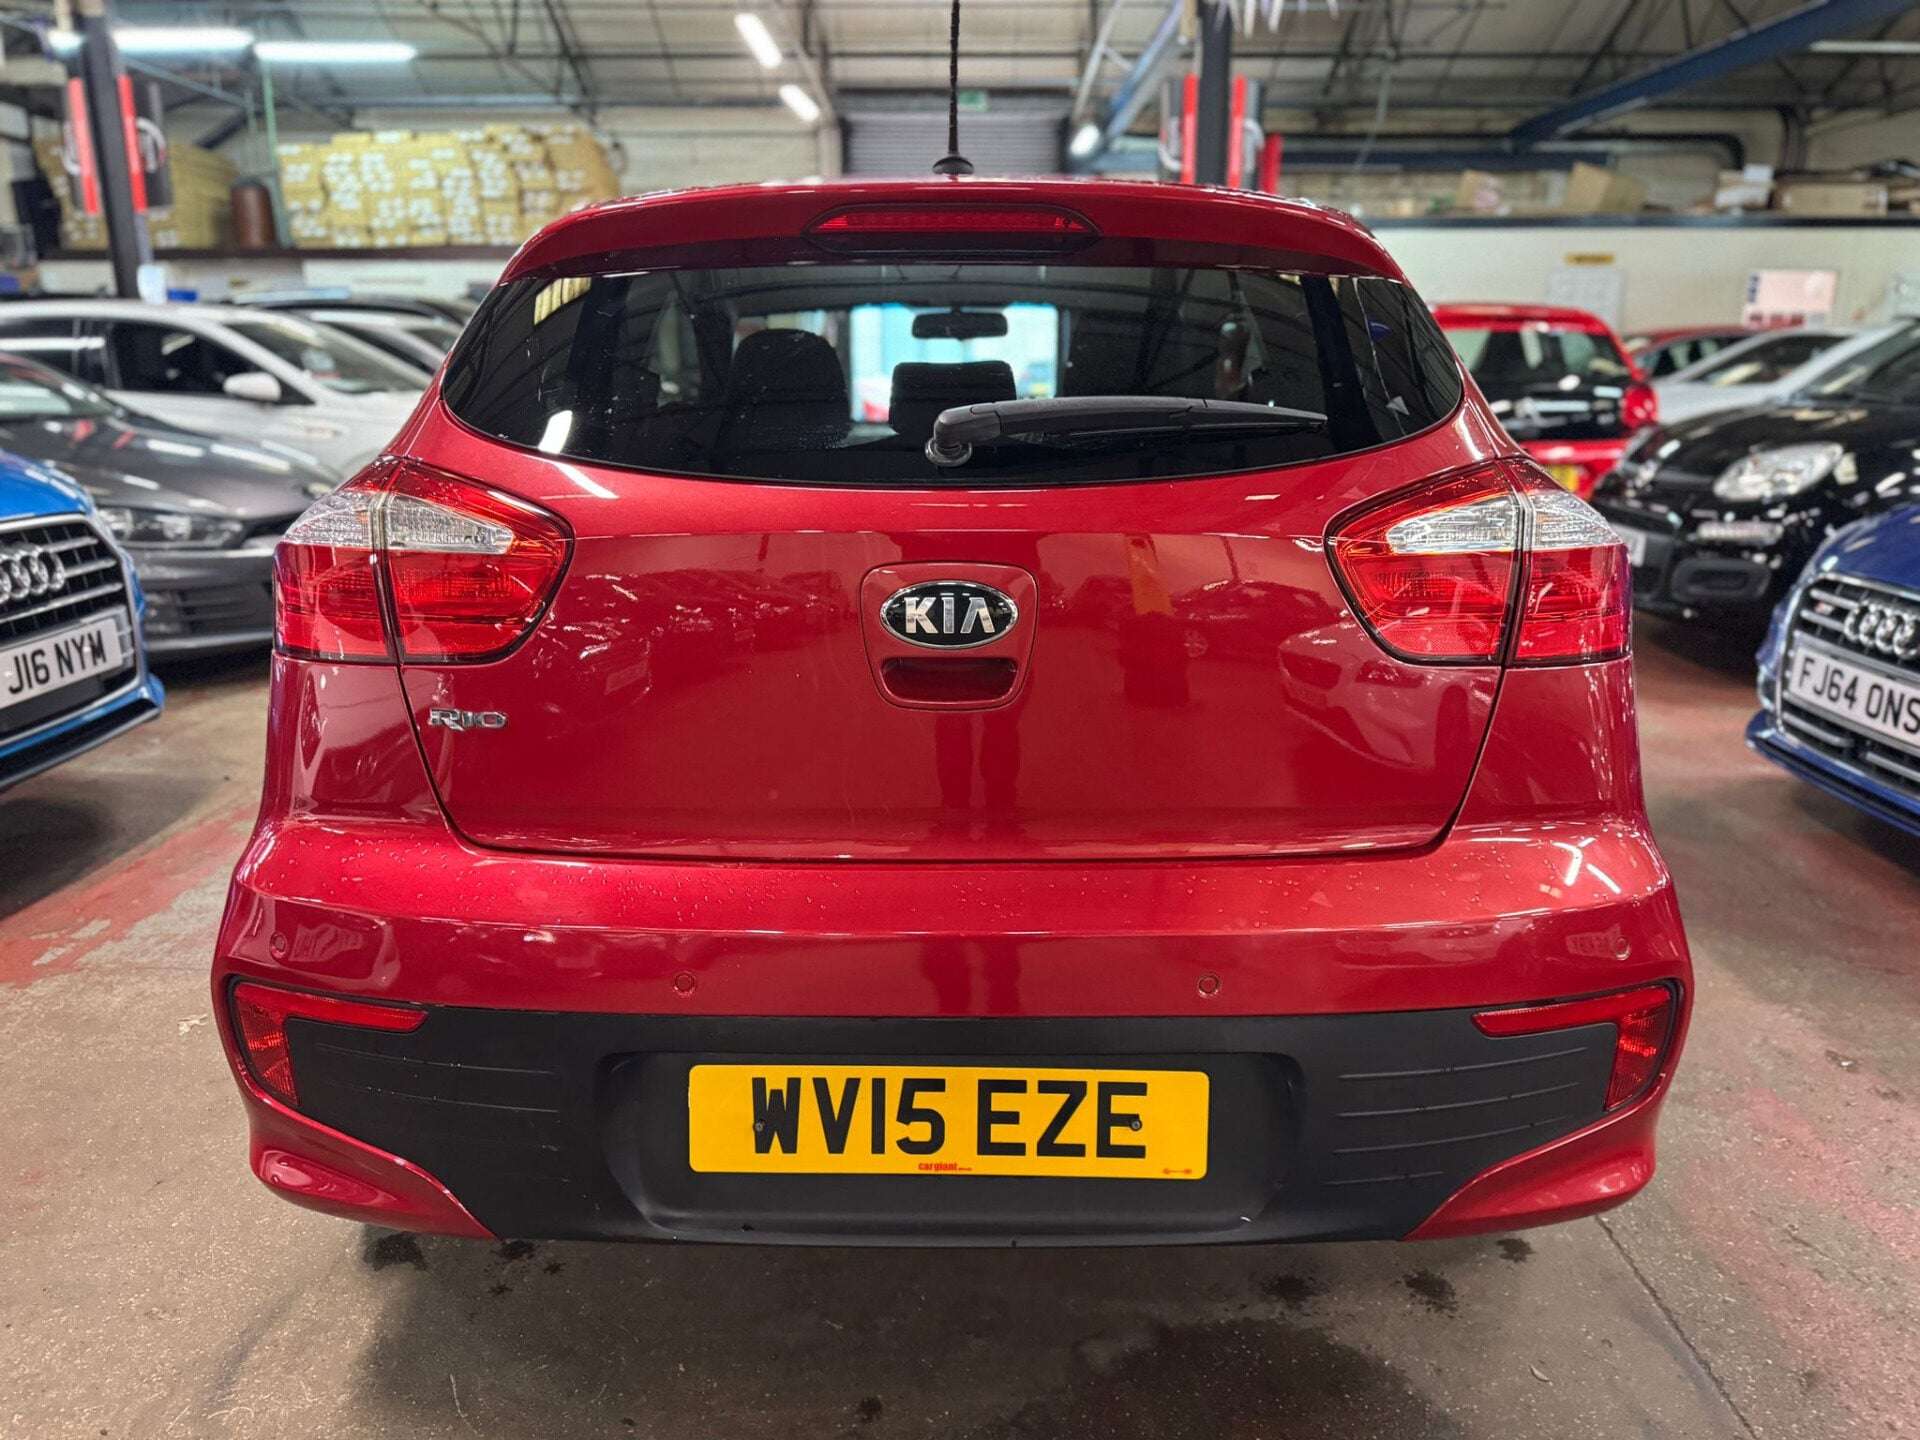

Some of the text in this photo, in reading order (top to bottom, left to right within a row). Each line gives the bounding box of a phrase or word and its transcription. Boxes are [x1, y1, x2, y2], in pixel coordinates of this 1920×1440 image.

[904, 592, 996, 634] KIA
[8, 630, 107, 695] J16 NYM
[429, 708, 507, 731] RIO
[1799, 657, 1920, 734] FJ64 ONS
[751, 1077, 1148, 1159] WV15 EZE
